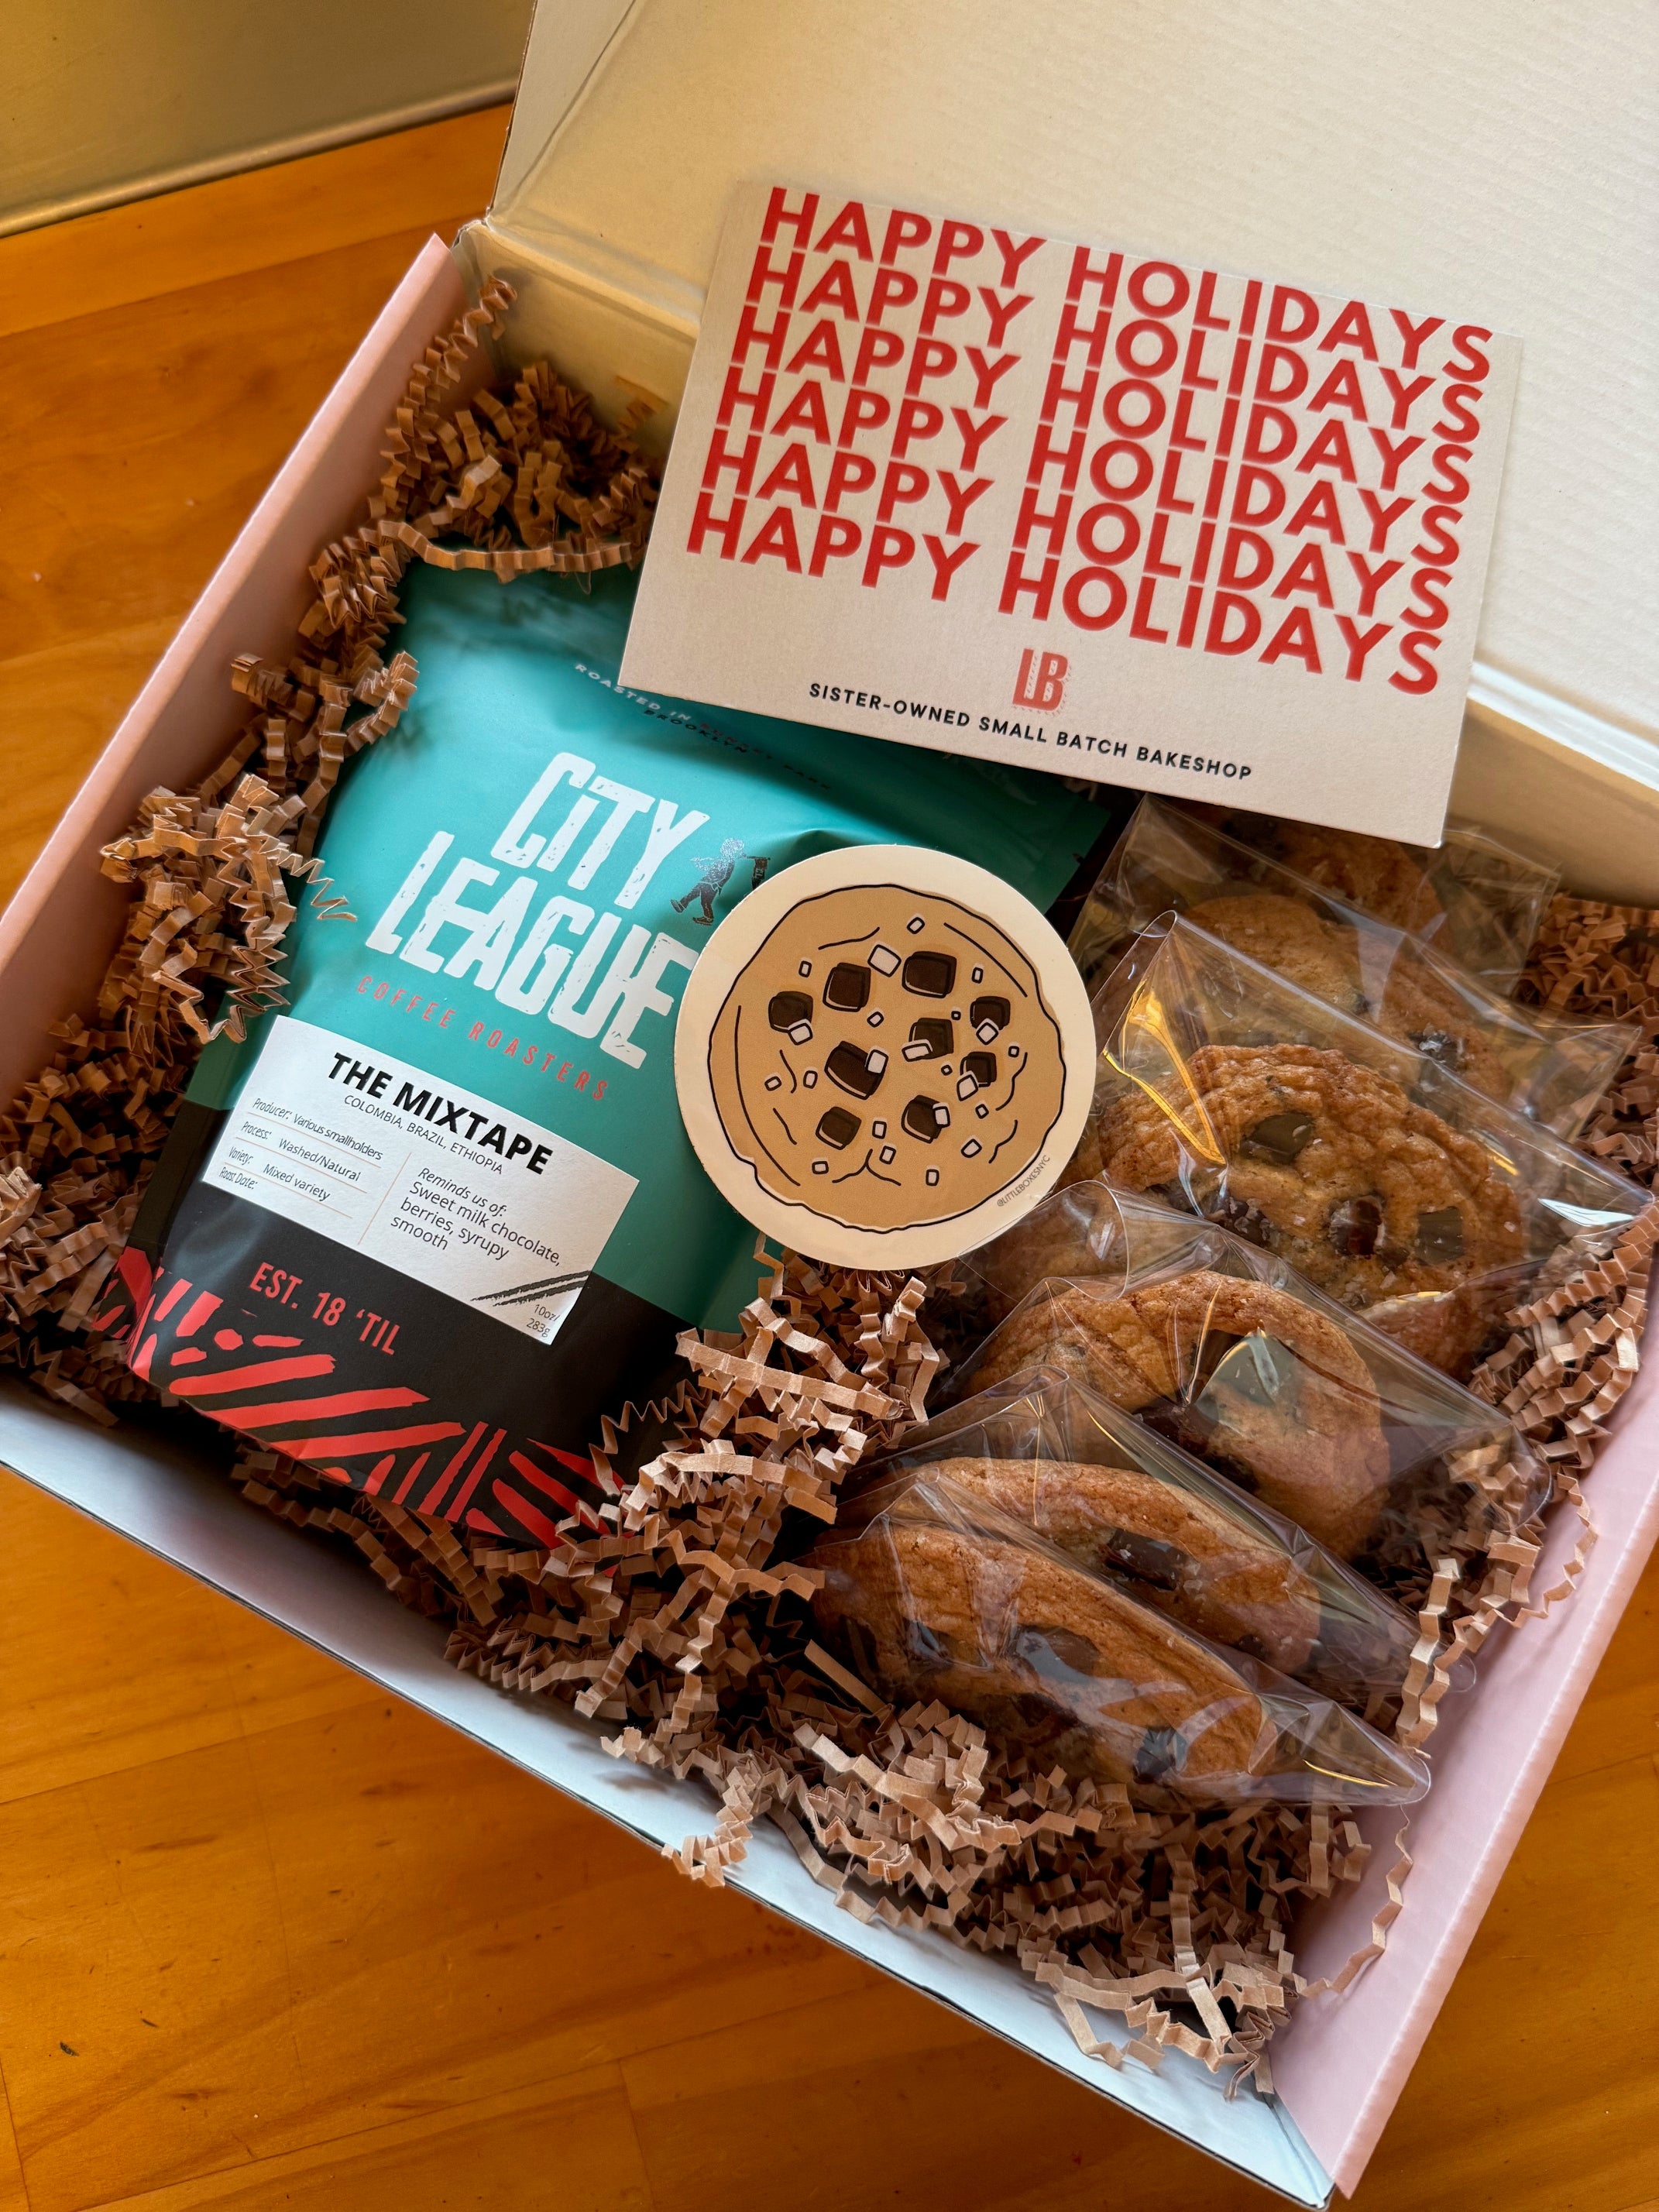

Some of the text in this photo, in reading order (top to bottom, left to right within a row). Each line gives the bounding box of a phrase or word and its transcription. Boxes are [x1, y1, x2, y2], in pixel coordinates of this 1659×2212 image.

[761, 187, 1492, 383] HAPPY HOLIDAYS
[745, 245, 1482, 443] HAPPY HOLIDAYS
[730, 305, 1471, 504] HAPPY HOLIDAYS
[716, 366, 1461, 567] HAPPY HOLIDAYS
[701, 428, 1452, 629] HAPPY HOLIDAYS
[687, 490, 1441, 695] HAPPY HOLIDAYS
[575, 664, 661, 710] ROASTED
[669, 711, 692, 721] IN
[809, 682, 1252, 781] SISTER-OWNED SMALL BATCH BAKESHOP
[491, 752, 710, 909] CITY
[366, 830, 699, 1070] LEAGUE
[357, 975, 608, 1101] COFFEE ROASTERS
[241, 1121, 361, 1182] Process: Washed/Natural
[252, 1097, 383, 1160] Producer: Various smallholders
[328, 1052, 554, 1175] THE MIXTAPE
[344, 1094, 503, 1175] COLOMBIA, BRAZIL, ETHIOPIA
[219, 1166, 258, 1190] Roast Date:
[228, 1146, 331, 1201] Variety: Mixed variety
[418, 1167, 507, 1217] Reminds us of:
[996, 1155, 1050, 1207] @LITTLEBOXESNYC
[390, 1217, 449, 1251] smooth
[400, 1197, 510, 1261] berries, syrupy
[409, 1181, 561, 1267] Sweet milk chocolate,
[249, 1262, 304, 1310] EST.
[312, 1292, 346, 1326] 18
[527, 1317, 551, 1338] 283g
